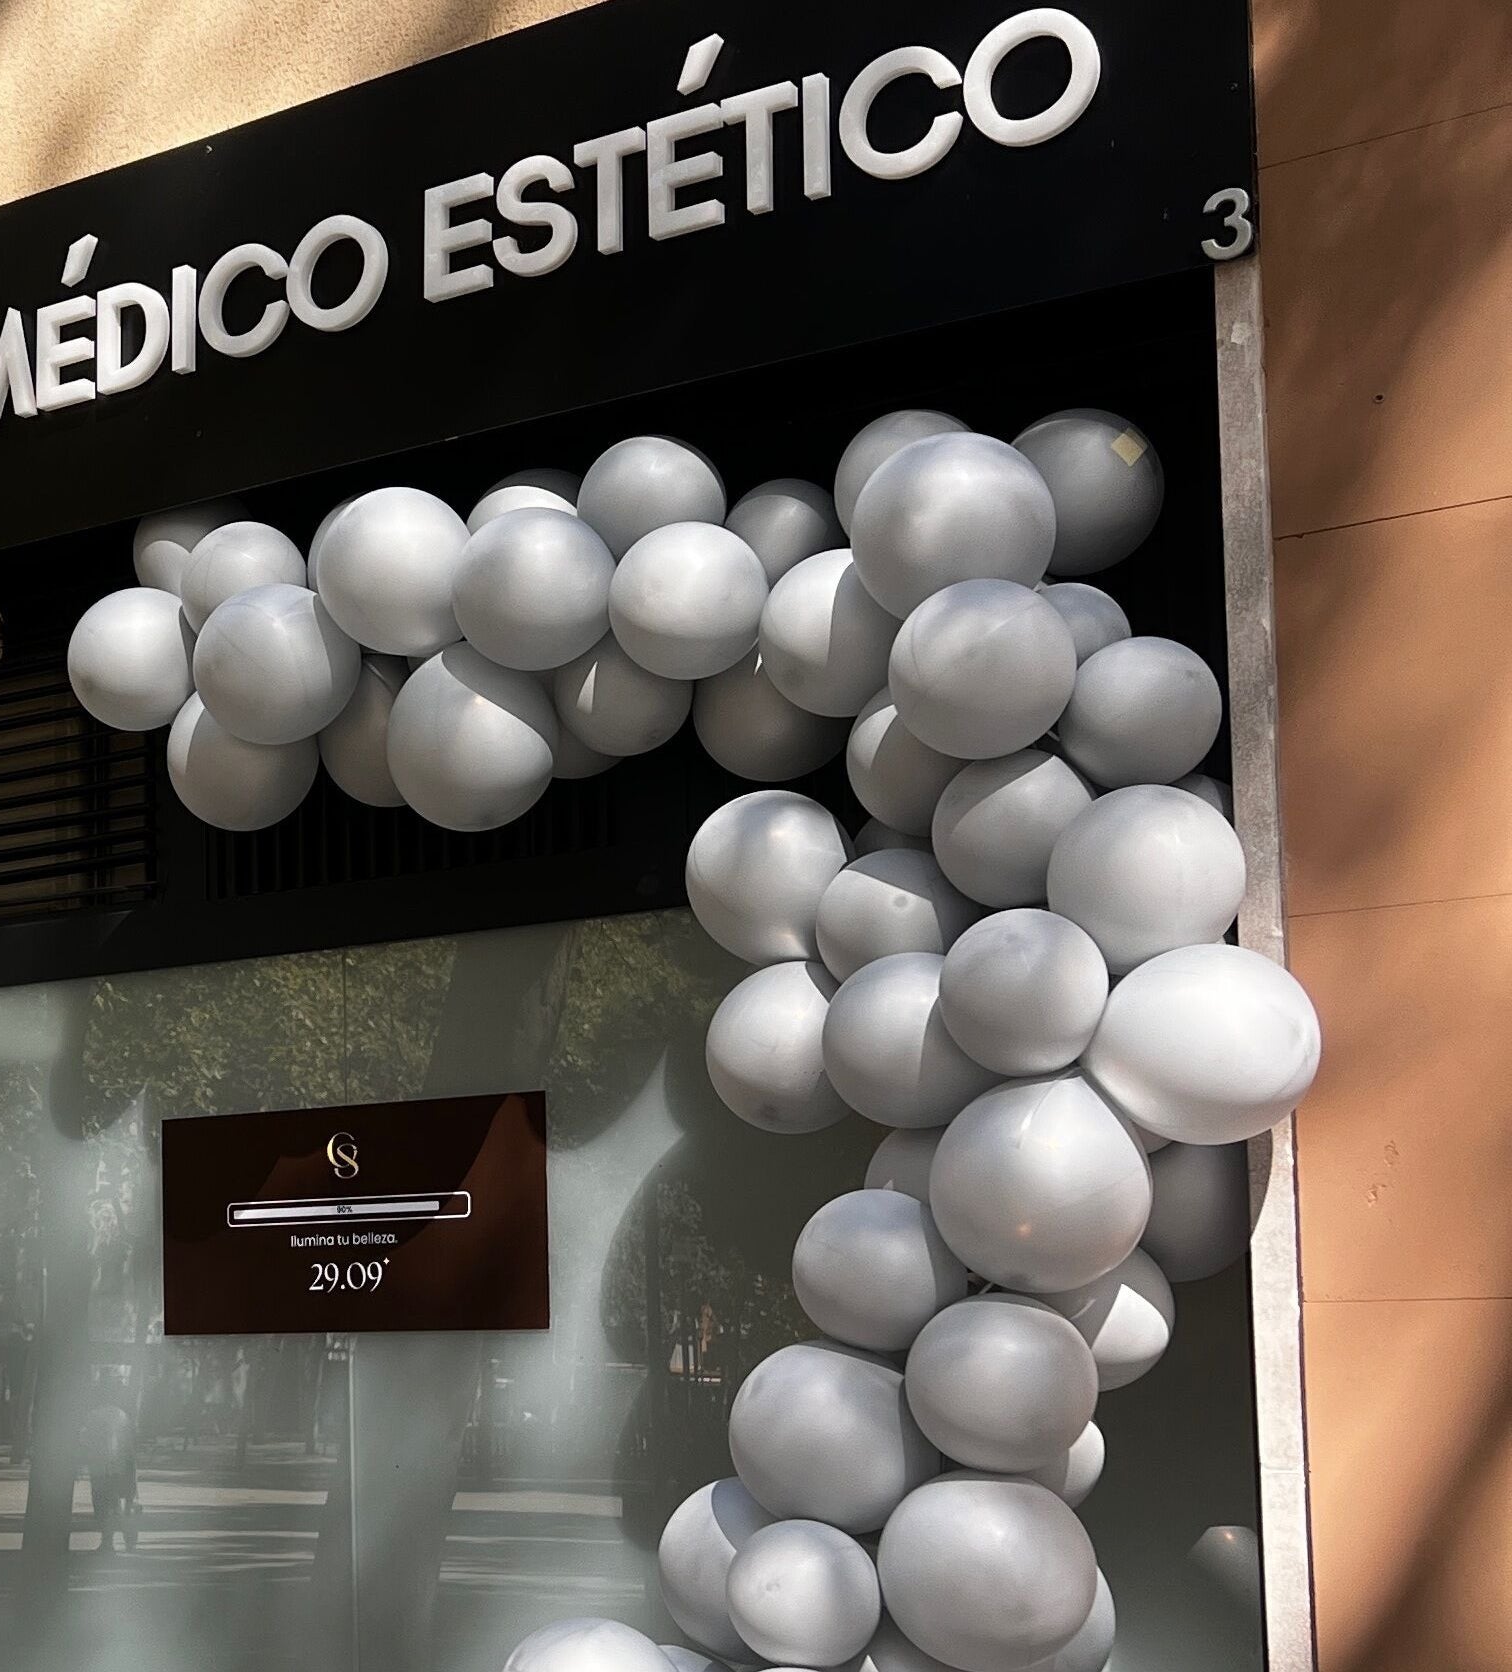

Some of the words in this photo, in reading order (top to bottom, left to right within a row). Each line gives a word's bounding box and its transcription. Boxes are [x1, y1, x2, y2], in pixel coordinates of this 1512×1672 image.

[423, 7, 1102, 303] ESTÉTICO
[1200, 187, 1252, 260] 3
[290, 1234, 335, 1248] Ilumina
[337, 1234, 350, 1246] tu
[352, 1231, 398, 1245] belleza.
